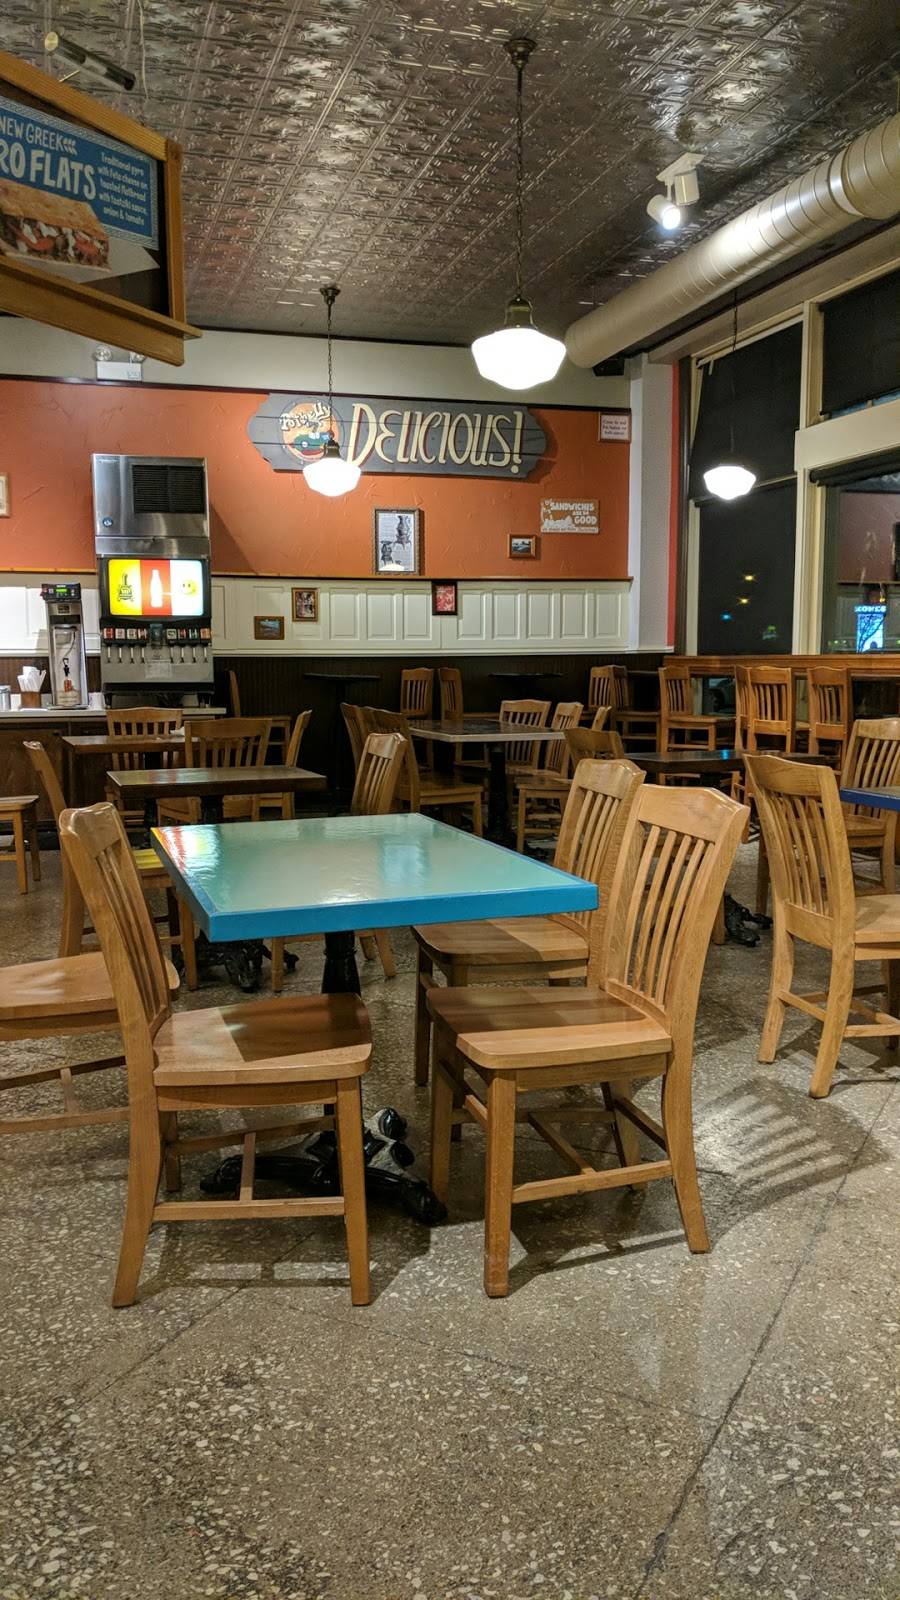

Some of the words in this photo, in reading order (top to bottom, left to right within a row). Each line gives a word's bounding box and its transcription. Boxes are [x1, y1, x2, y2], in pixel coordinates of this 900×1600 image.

[0, 115, 24, 139] NEW
[25, 123, 64, 152] GREEK
[30, 149, 96, 200] FLATS
[350, 403, 522, 474] DELICIOUS!
[574, 515, 597, 525] GOOD
